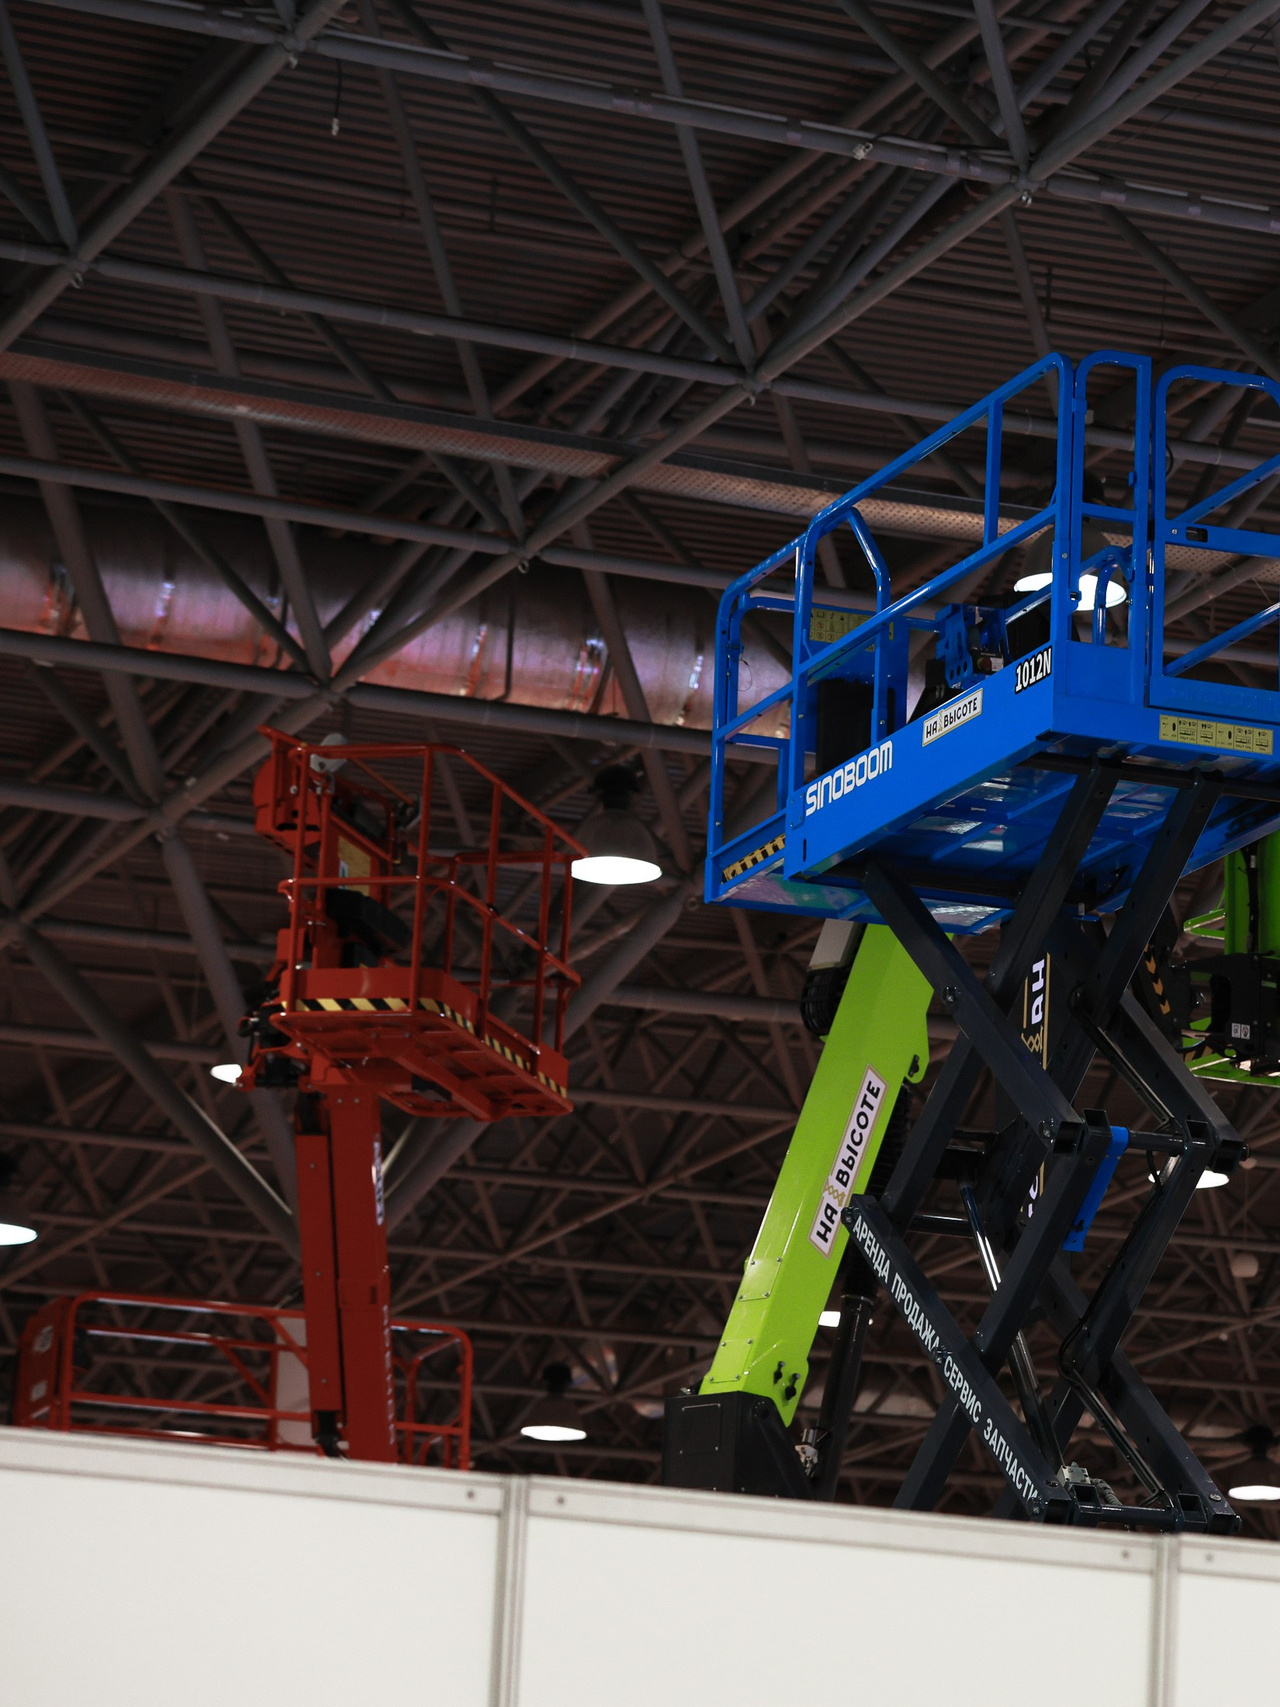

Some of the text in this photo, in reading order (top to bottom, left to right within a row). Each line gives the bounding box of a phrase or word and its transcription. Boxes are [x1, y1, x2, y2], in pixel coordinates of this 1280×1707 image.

[1015, 647, 1052, 692] 1012N
[926, 697, 978, 738] НА ВЫСОТЕ
[806, 740, 892, 816] SINOBOOM
[816, 1081, 880, 1243] НА ВЫСОТЕ
[852, 1215, 889, 1284] АРЕНДА
[944, 1355, 981, 1423] СЕРВИС
